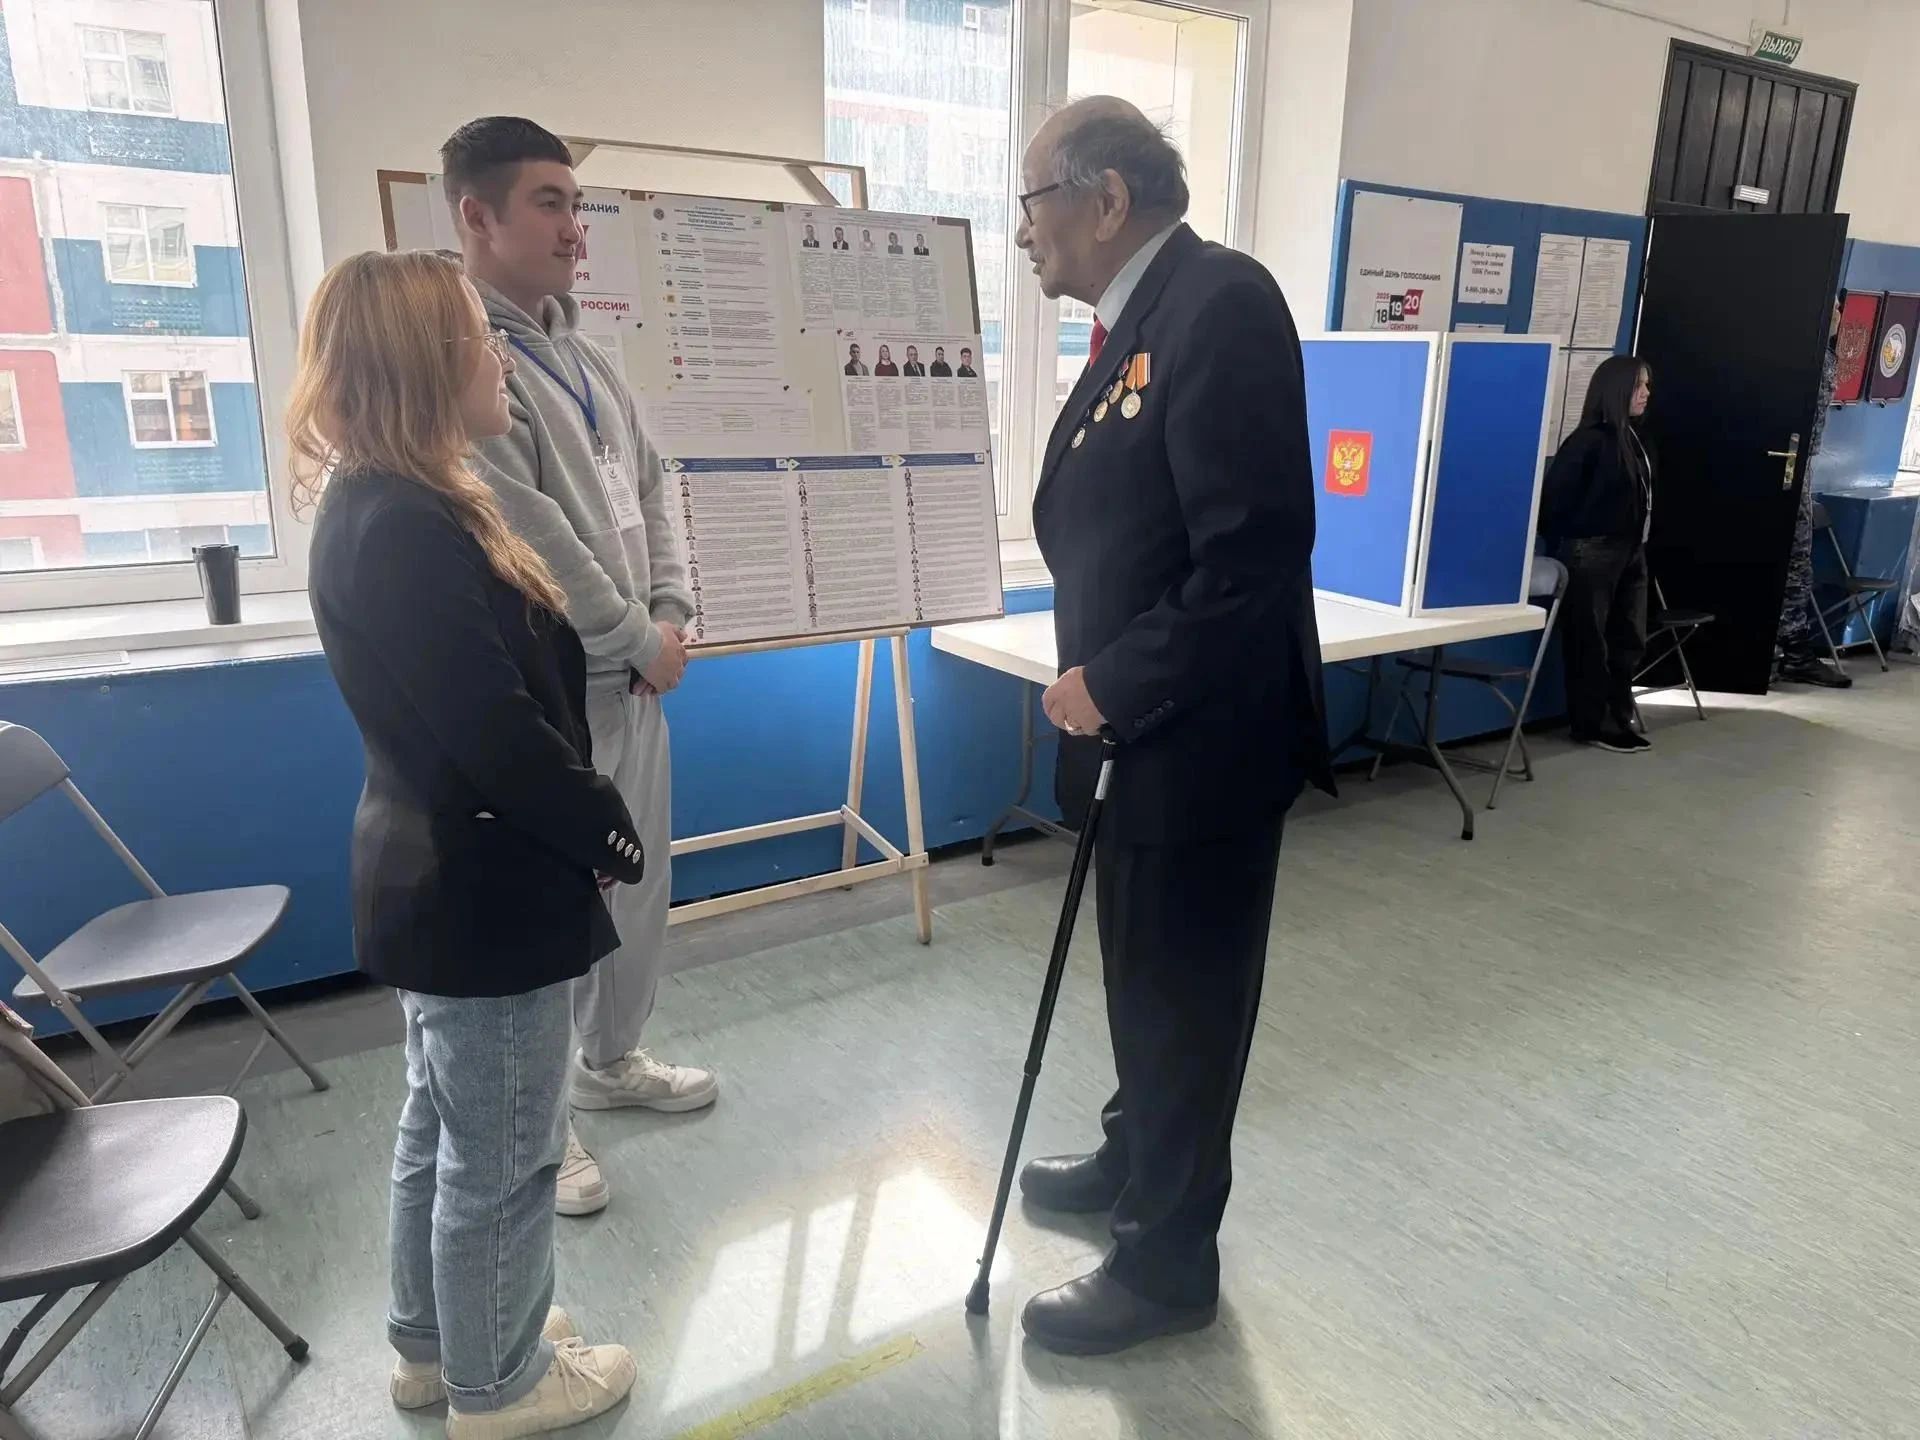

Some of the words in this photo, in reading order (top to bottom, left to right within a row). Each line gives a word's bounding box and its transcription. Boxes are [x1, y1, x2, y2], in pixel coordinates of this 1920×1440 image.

[1760, 35, 1799, 61] ВЫХОД
[581, 202, 620, 215] ВАНИЯ
[1359, 268, 1384, 277] ЕДИНЫЙ
[1384, 270, 1400, 278] ДЕНЬ
[1400, 272, 1441, 281] ГОЛОСОВАНИЯ
[580, 300, 630, 312] РОССИИ!
[1376, 308, 1388, 324] 18
[1391, 301, 1402, 317] 19
[1404, 295, 1420, 310] 20
